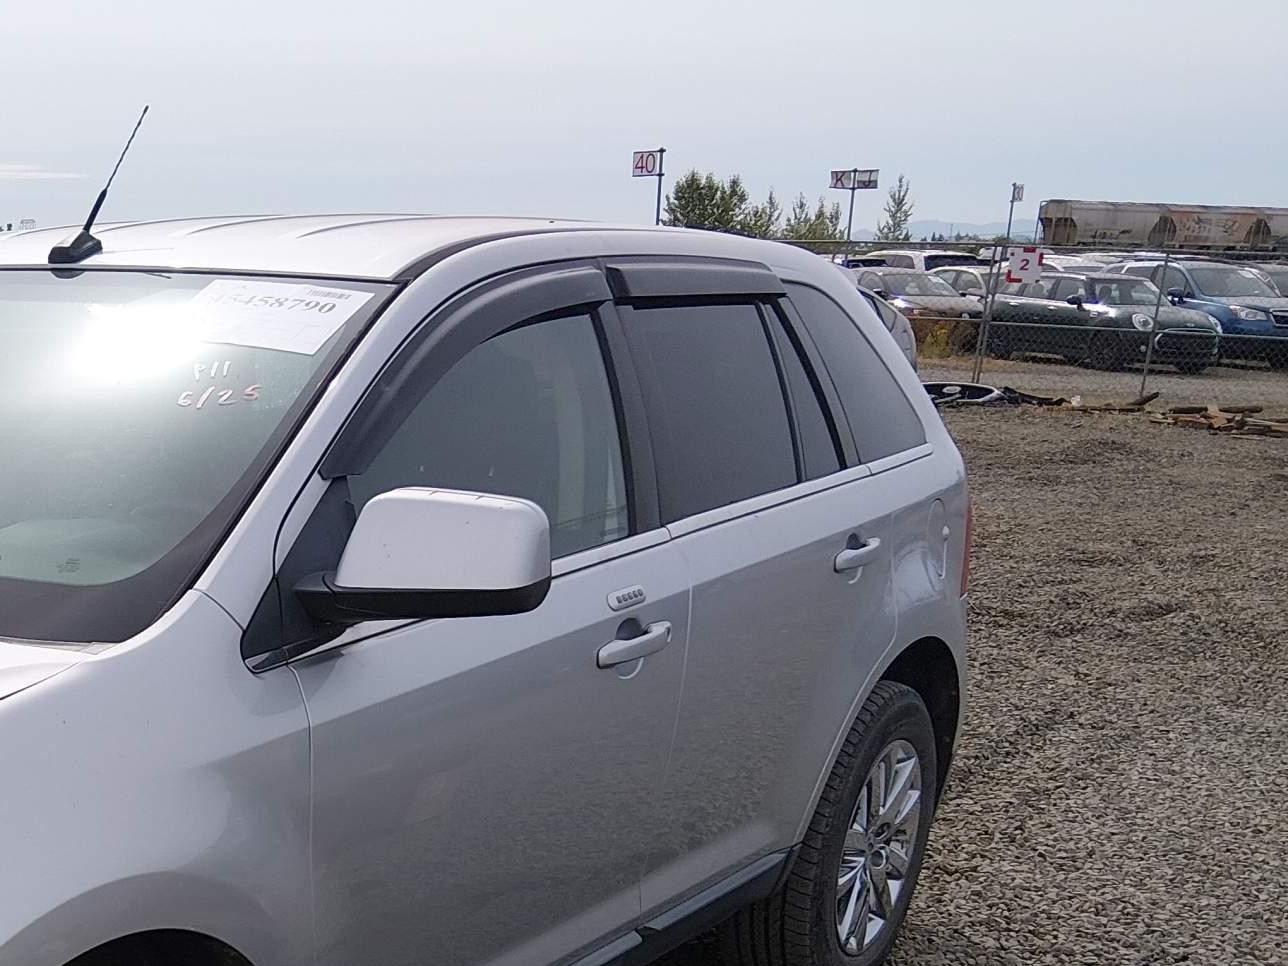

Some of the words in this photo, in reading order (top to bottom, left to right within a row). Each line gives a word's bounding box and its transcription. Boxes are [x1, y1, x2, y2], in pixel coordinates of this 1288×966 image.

[634, 153, 656, 173] 40
[833, 171, 846, 187] K
[1019, 258, 1030, 271] 2
[209, 295, 337, 314] 5458790
